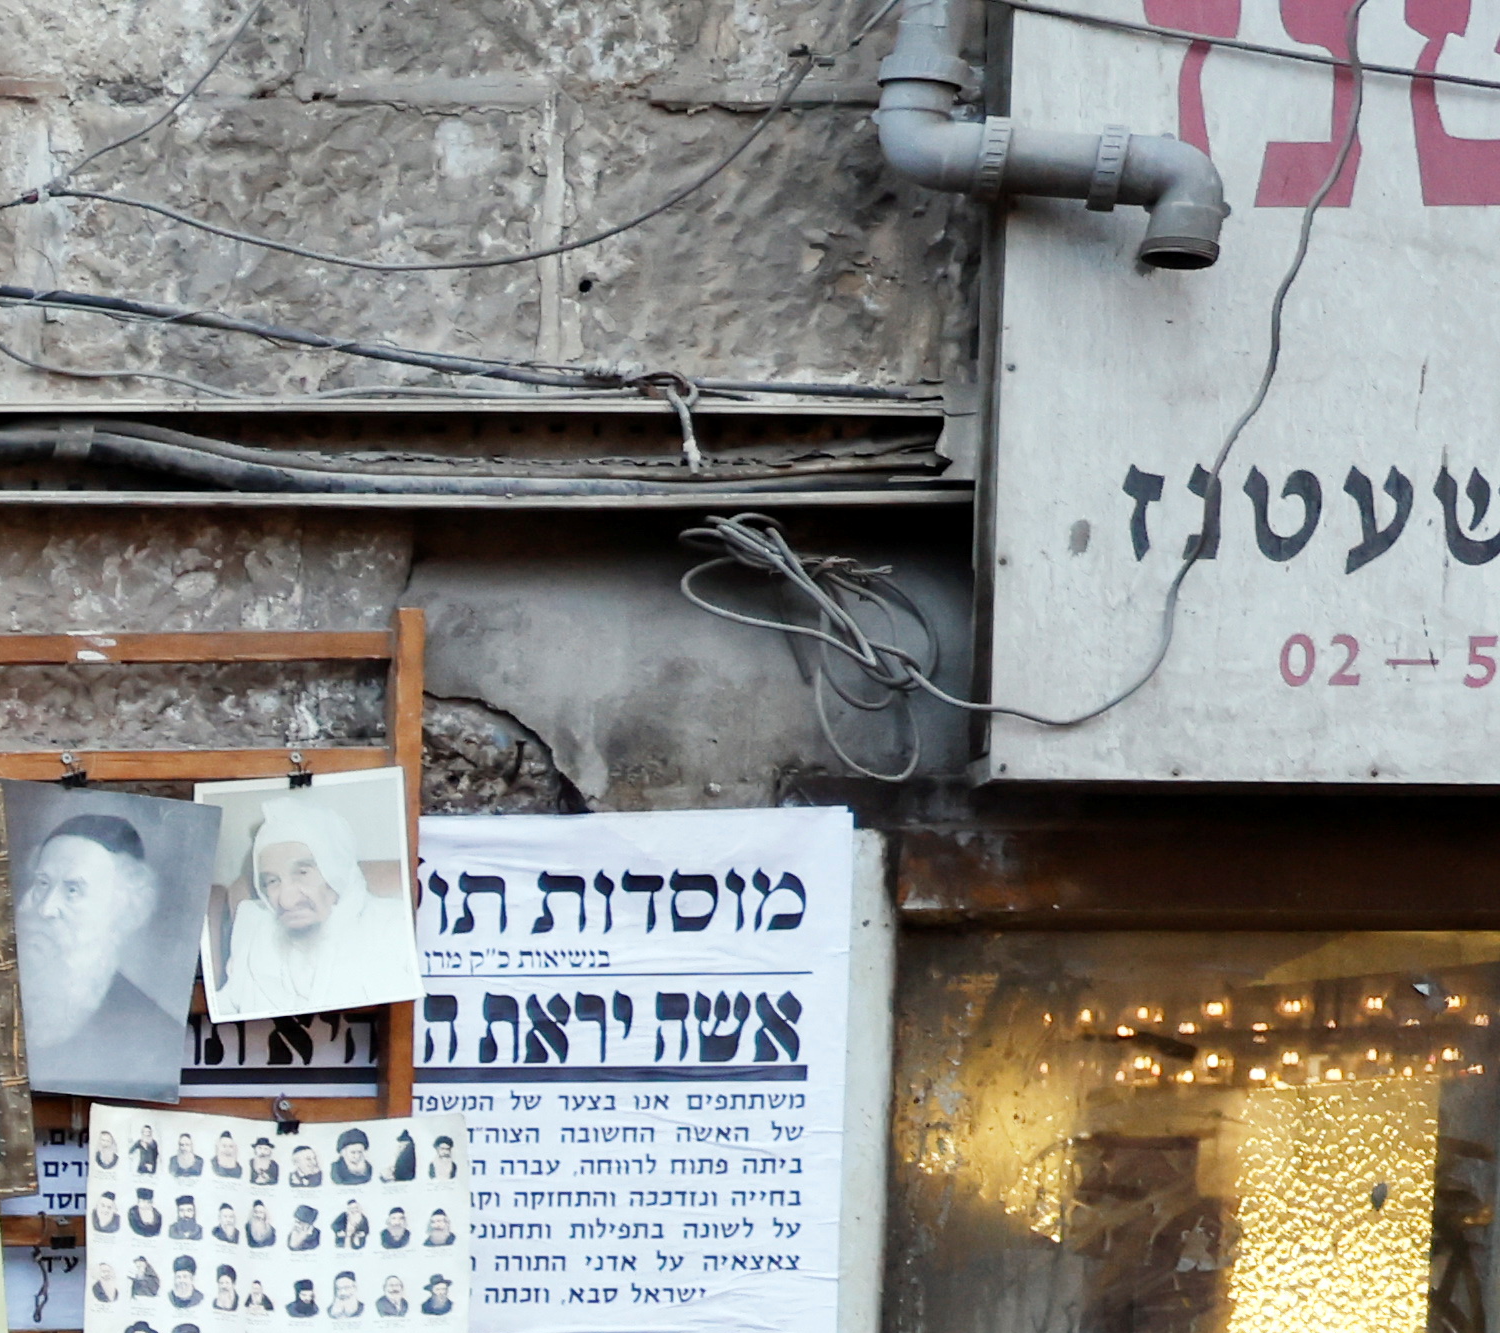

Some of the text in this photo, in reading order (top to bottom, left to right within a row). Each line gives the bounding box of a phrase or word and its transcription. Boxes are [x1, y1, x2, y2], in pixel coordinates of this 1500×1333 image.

[418, 867, 807, 936] מוסדות תו
[424, 948, 611, 971] בנשיאות כ"ק מרן
[478, 990, 634, 1064] יראת
[654, 990, 803, 1063] אשה
[510, 1088, 806, 1112] משתתפים אנו בצער של
[499, 1153, 803, 1177] ביתה פתוח לרווחה, עברה
